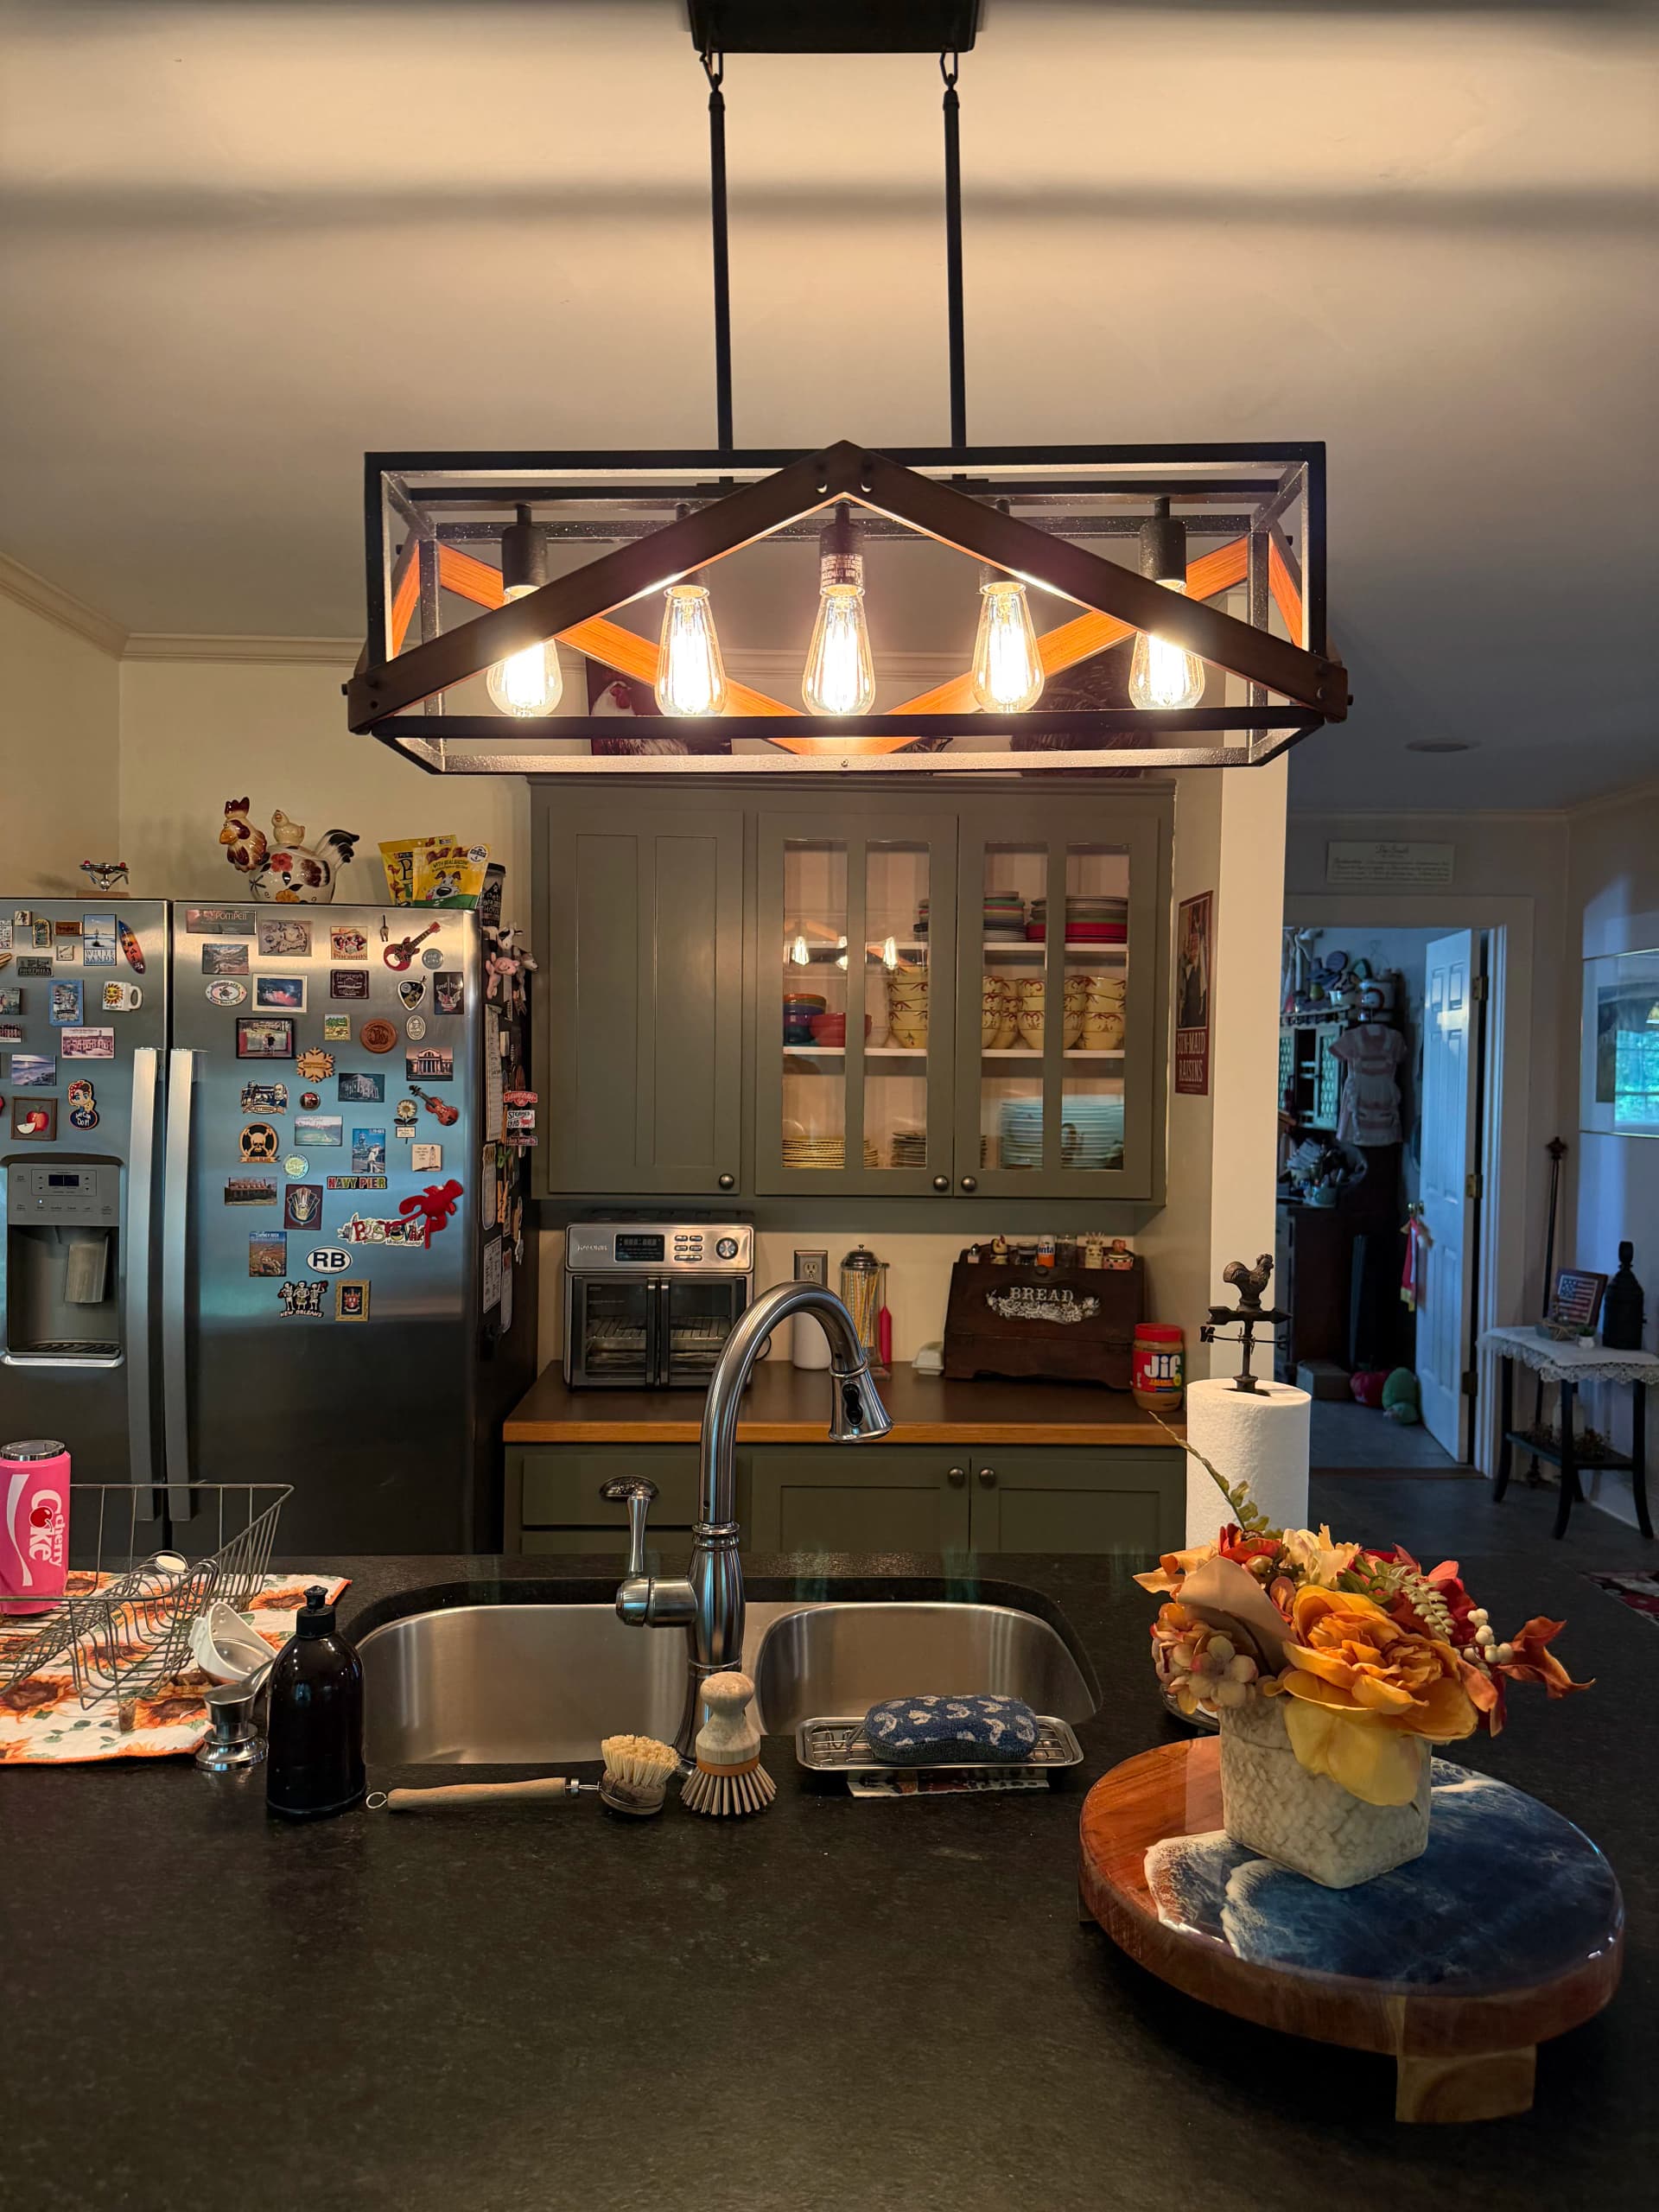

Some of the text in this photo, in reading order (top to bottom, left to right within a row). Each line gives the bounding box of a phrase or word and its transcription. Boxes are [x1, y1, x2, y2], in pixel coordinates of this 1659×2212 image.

[1179, 1058, 1203, 1083] RAISINS
[327, 1177, 386, 1189] NAVY PIER
[313, 1252, 346, 1268] RB
[1009, 1287, 1074, 1302] BREAD
[296, 1309, 324, 1318] ORLEANS
[1143, 1355, 1181, 1378] Jif
[48, 1514, 66, 1567] cherry
